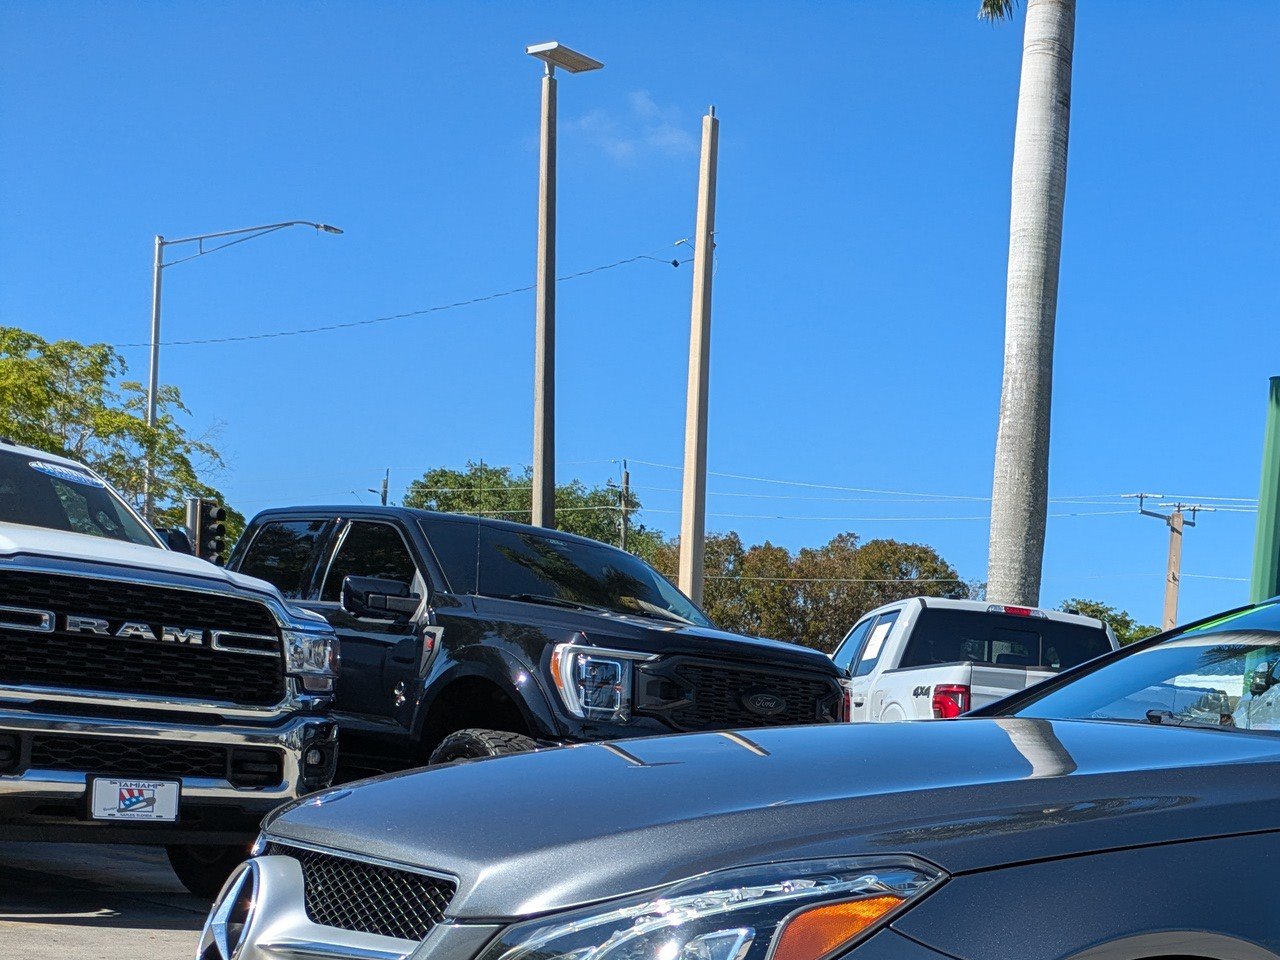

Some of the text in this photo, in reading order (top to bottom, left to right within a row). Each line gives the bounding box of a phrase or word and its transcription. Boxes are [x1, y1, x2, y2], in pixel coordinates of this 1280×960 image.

[66, 615, 204, 645] RAM
[755, 696, 776, 708] Ford
[119, 781, 158, 789] TAMIAMI
